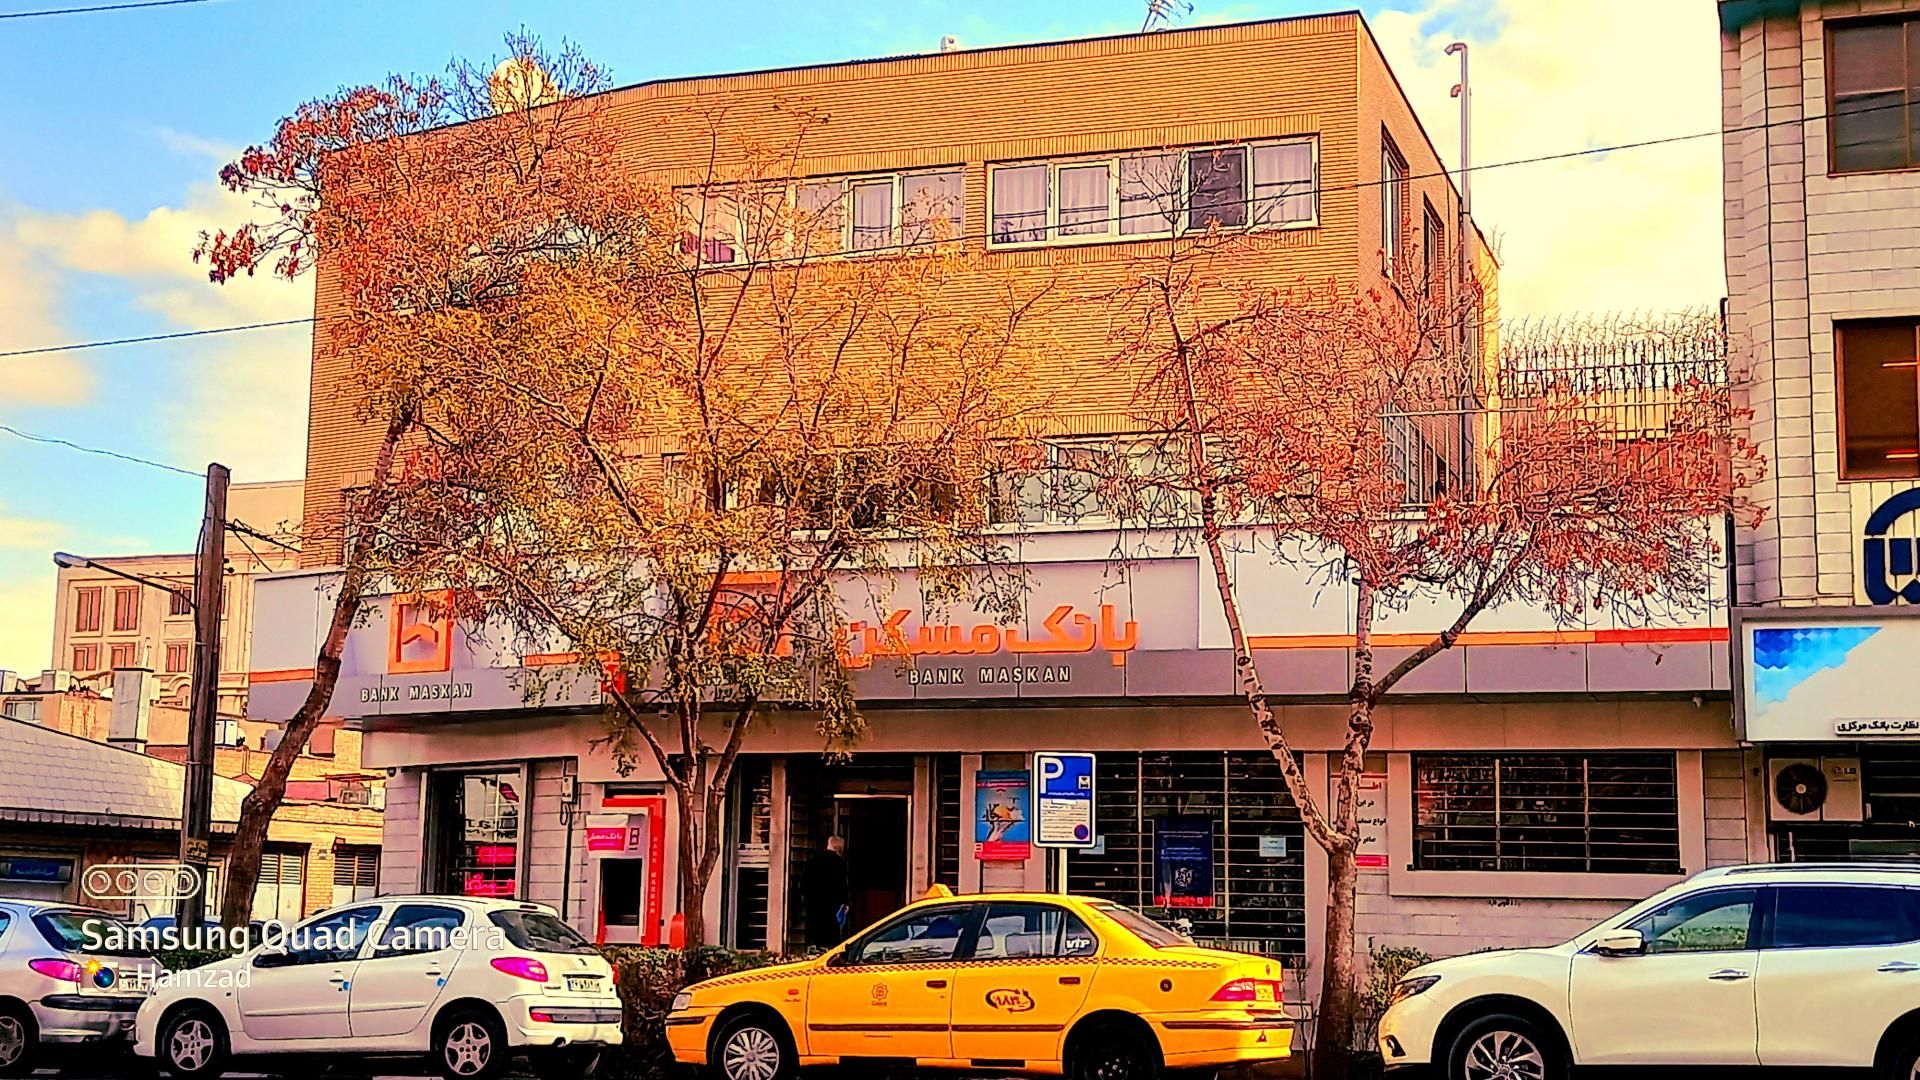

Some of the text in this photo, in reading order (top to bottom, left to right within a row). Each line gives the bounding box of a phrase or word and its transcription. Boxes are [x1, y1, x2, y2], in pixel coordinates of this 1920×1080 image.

[834, 605, 1137, 669] بانک مسکن
[909, 666, 1071, 685] BANK MASKAN
[361, 683, 472, 703] BANK MASKAN
[1837, 720, 1868, 732] مرکزی
[1868, 720, 1890, 732] بانک
[1040, 757, 1064, 794] P
[1066, 937, 1090, 948] VIP
